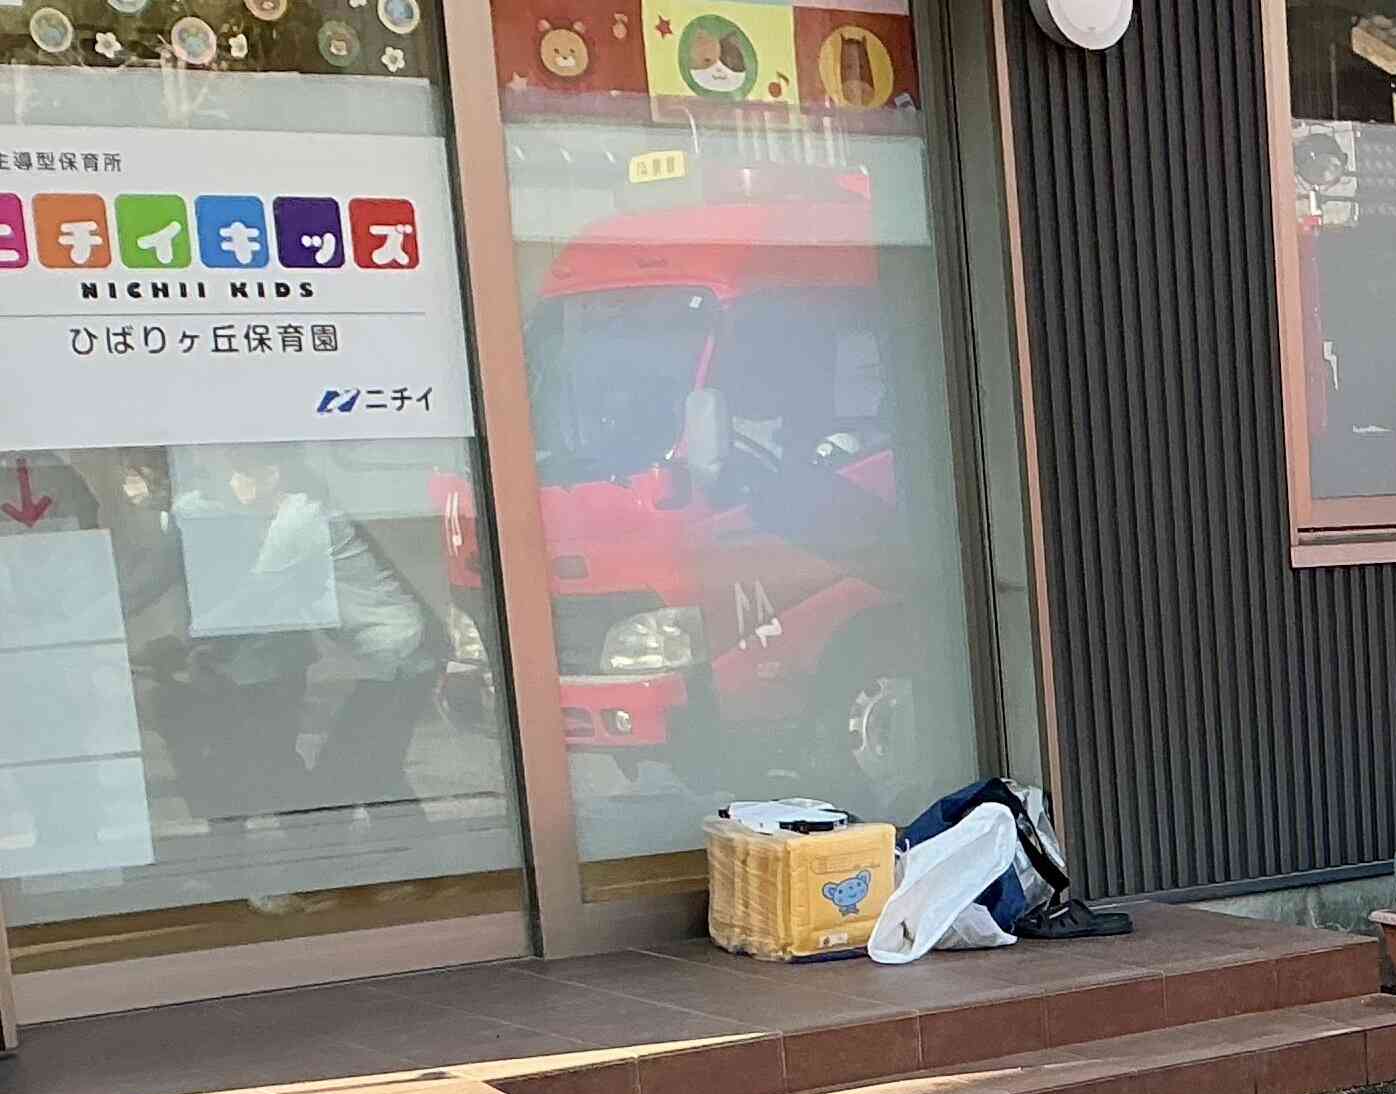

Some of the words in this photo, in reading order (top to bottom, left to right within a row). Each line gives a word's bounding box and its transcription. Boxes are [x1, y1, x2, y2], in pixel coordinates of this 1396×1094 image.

[81, 282, 206, 299] NICHII
[230, 282, 314, 298] KIDS
[365, 387, 432, 411] ニチイ
